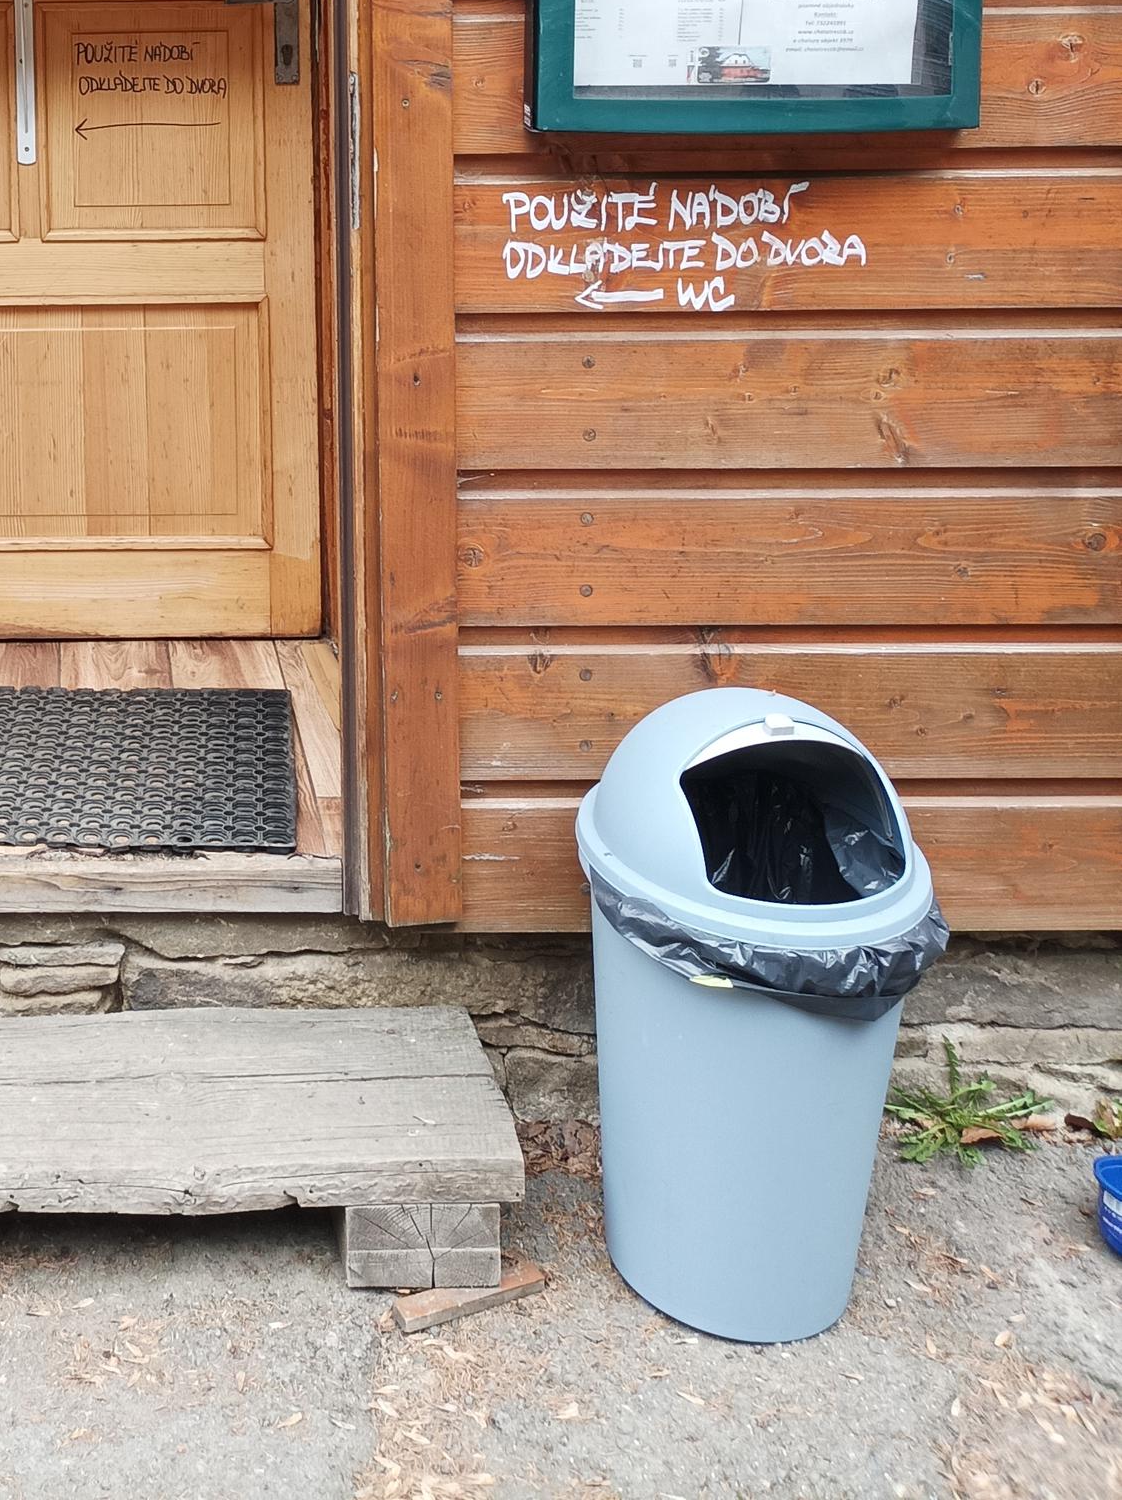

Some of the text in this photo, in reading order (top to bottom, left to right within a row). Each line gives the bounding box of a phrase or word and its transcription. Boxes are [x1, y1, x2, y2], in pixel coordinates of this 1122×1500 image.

[75, 40, 201, 66] POUŽITÉ NÁDOBÍ
[79, 70, 227, 99] ODKLÁDEJTE DO DVORA
[503, 180, 810, 233] POUŽITÉ NÁDOBÍ
[503, 230, 867, 280] ODKLÁDEJTE DO DVORA
[677, 277, 736, 312] WC
